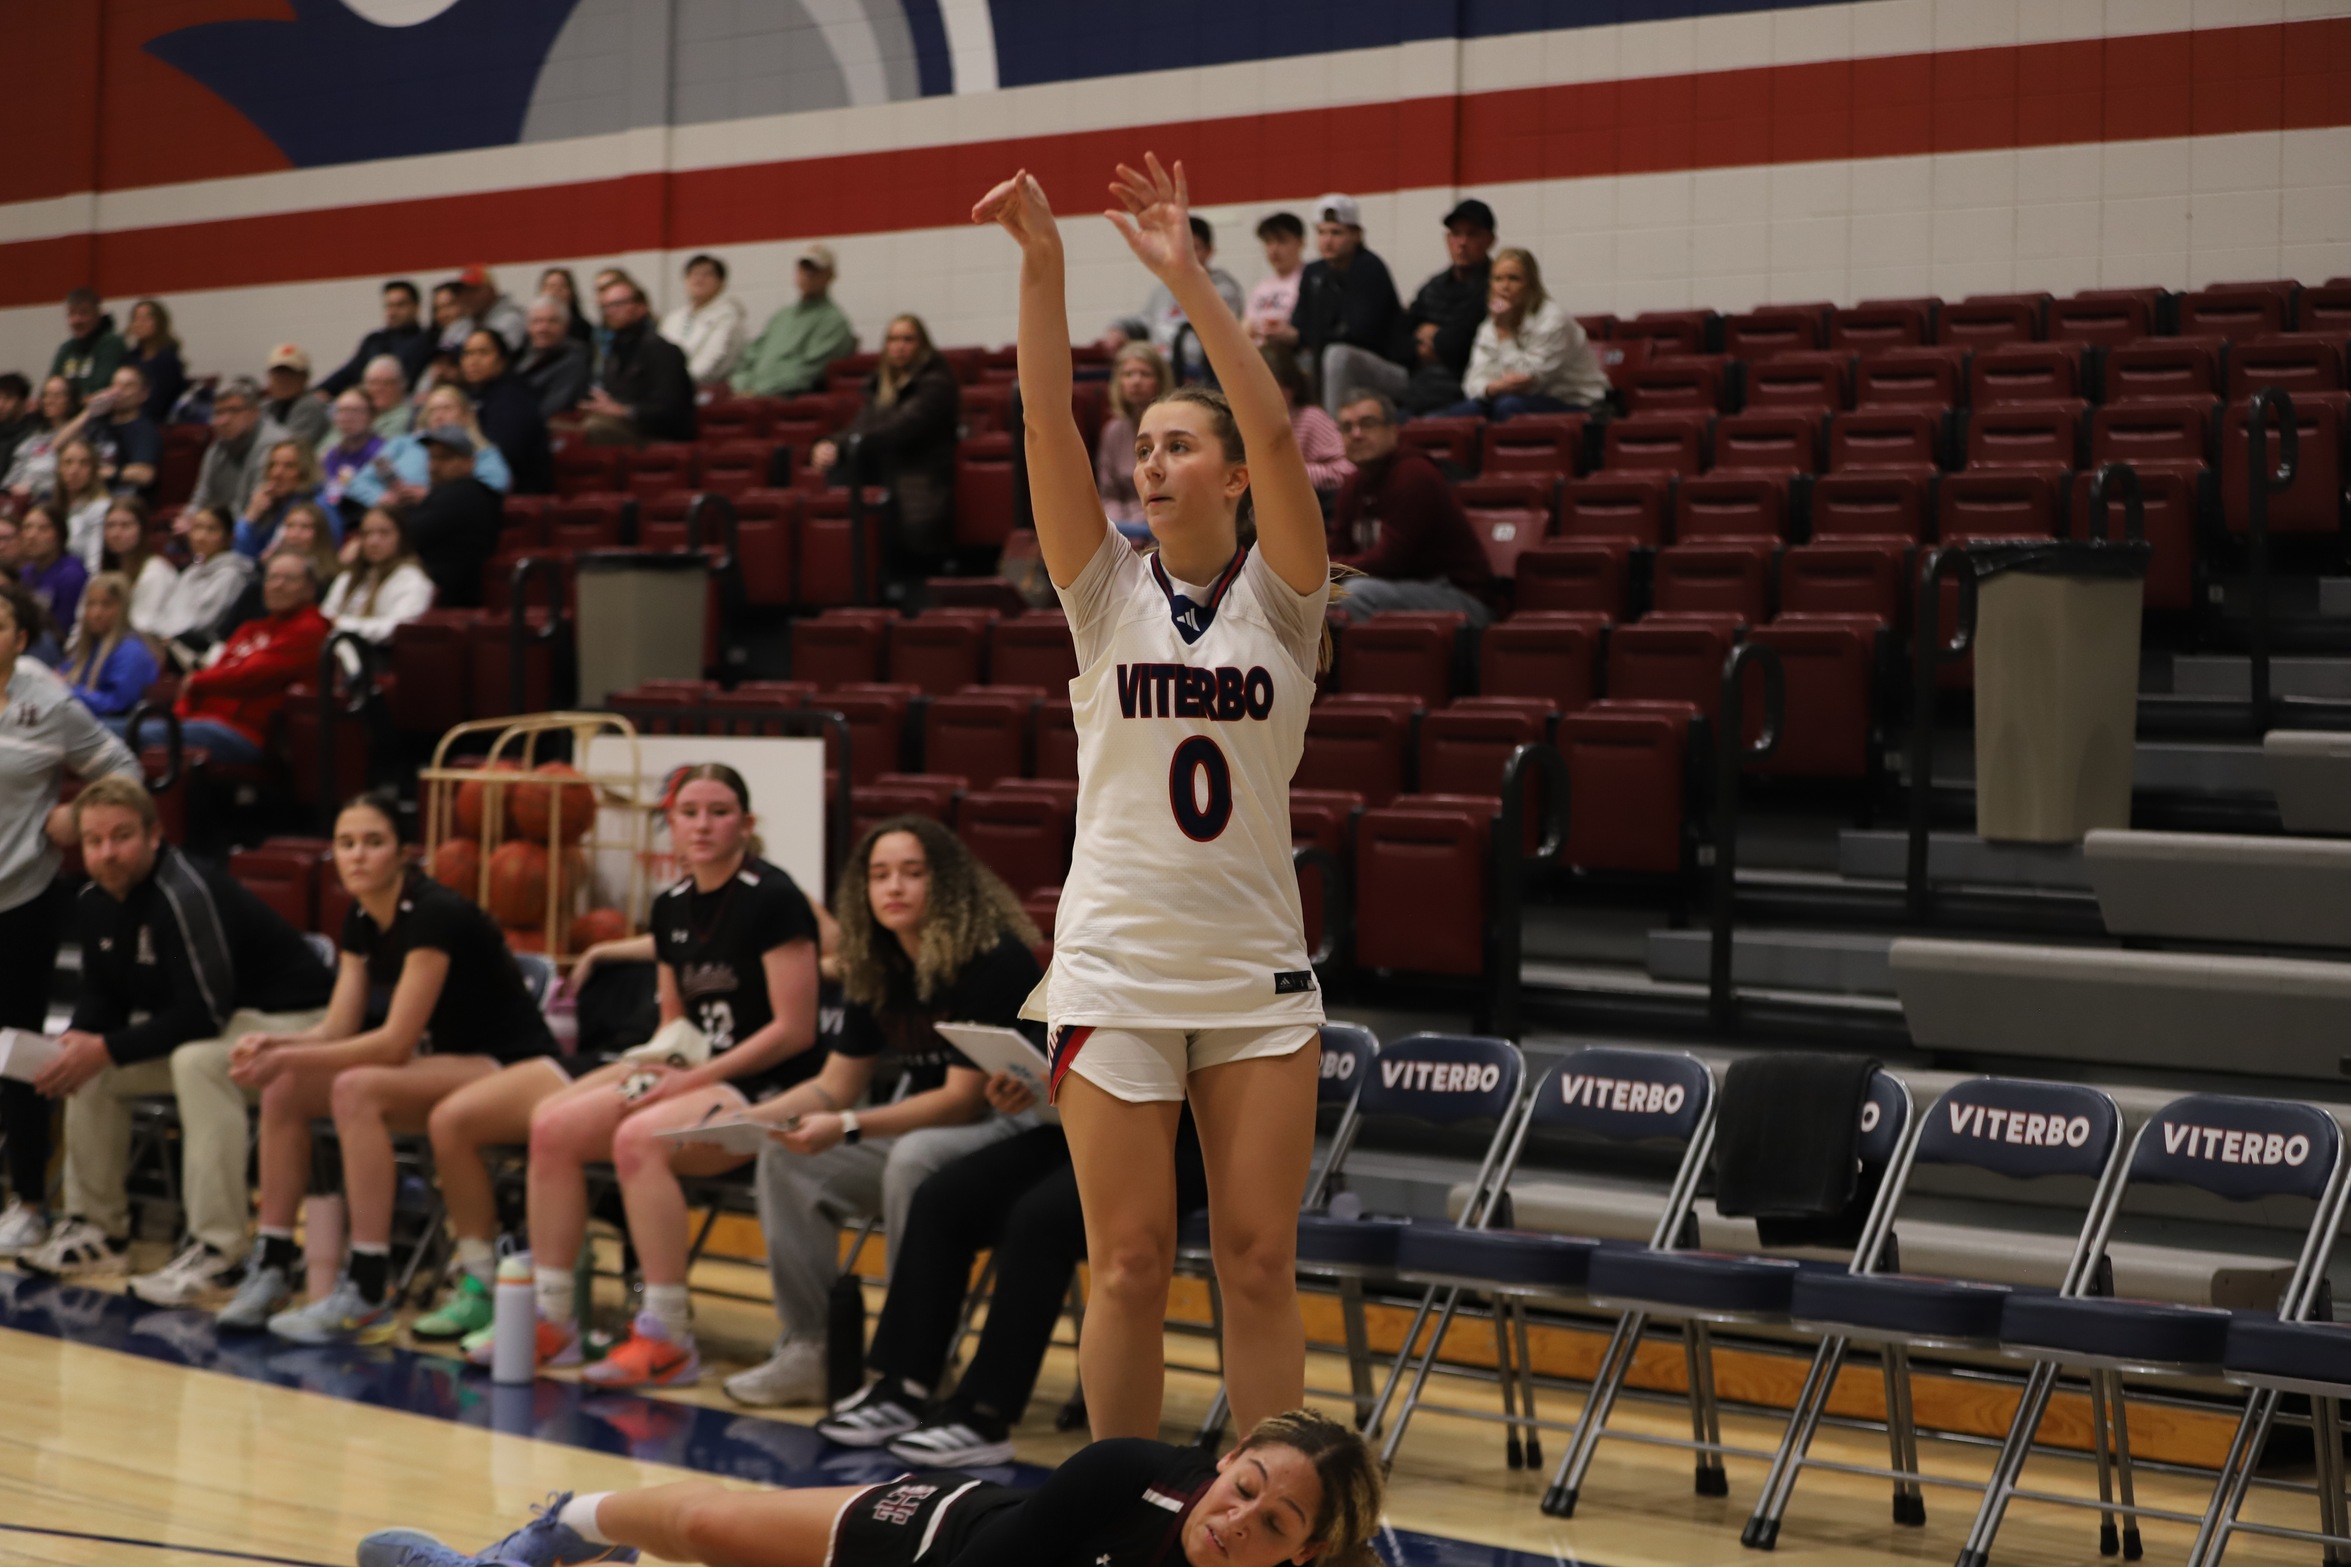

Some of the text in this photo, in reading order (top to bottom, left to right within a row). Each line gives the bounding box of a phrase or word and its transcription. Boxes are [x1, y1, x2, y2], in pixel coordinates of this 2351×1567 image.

[1116, 662, 1275, 722] VITERBO
[1380, 1059, 1501, 1094] VITERBO
[1560, 1072, 1686, 1115] VITERBO
[1948, 1102, 2091, 1149] VITERBO
[2162, 1121, 2311, 1168] VITERBO
